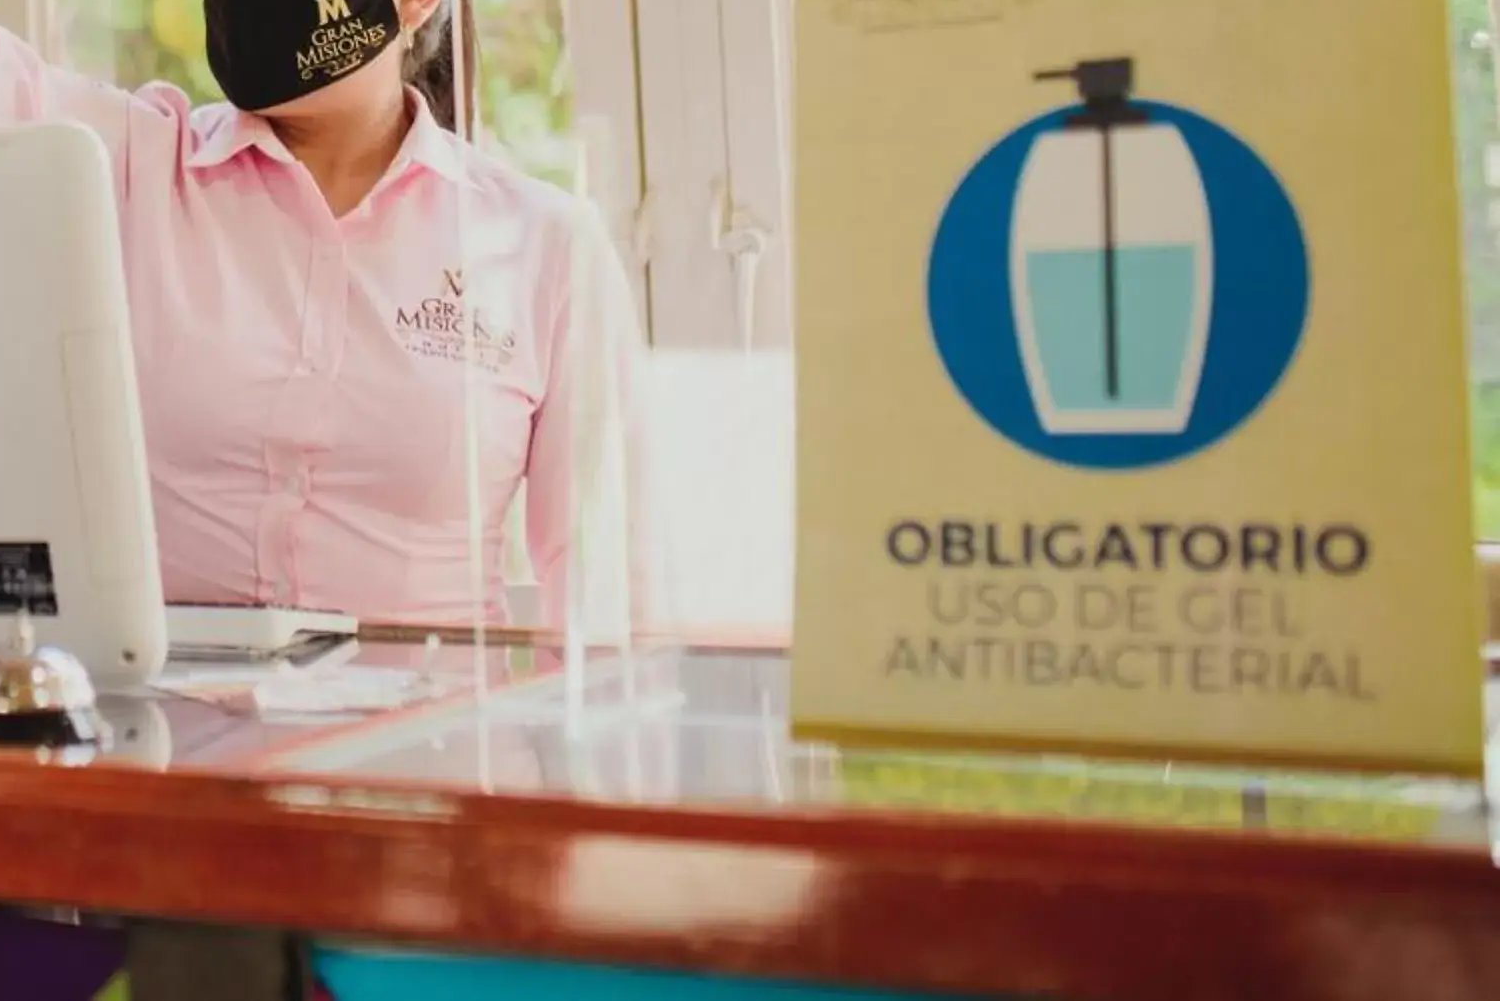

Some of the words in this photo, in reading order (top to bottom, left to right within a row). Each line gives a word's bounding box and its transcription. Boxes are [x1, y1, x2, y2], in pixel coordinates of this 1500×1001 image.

[295, 22, 386, 71] MISIONES
[311, 17, 363, 46] GRAN
[885, 520, 1371, 576] OBLIGATORIO
[926, 581, 1058, 629] USO
[1073, 585, 1158, 633] DE
[1176, 586, 1302, 638] GEL
[884, 635, 1377, 701] ANTIBACTERIAL
